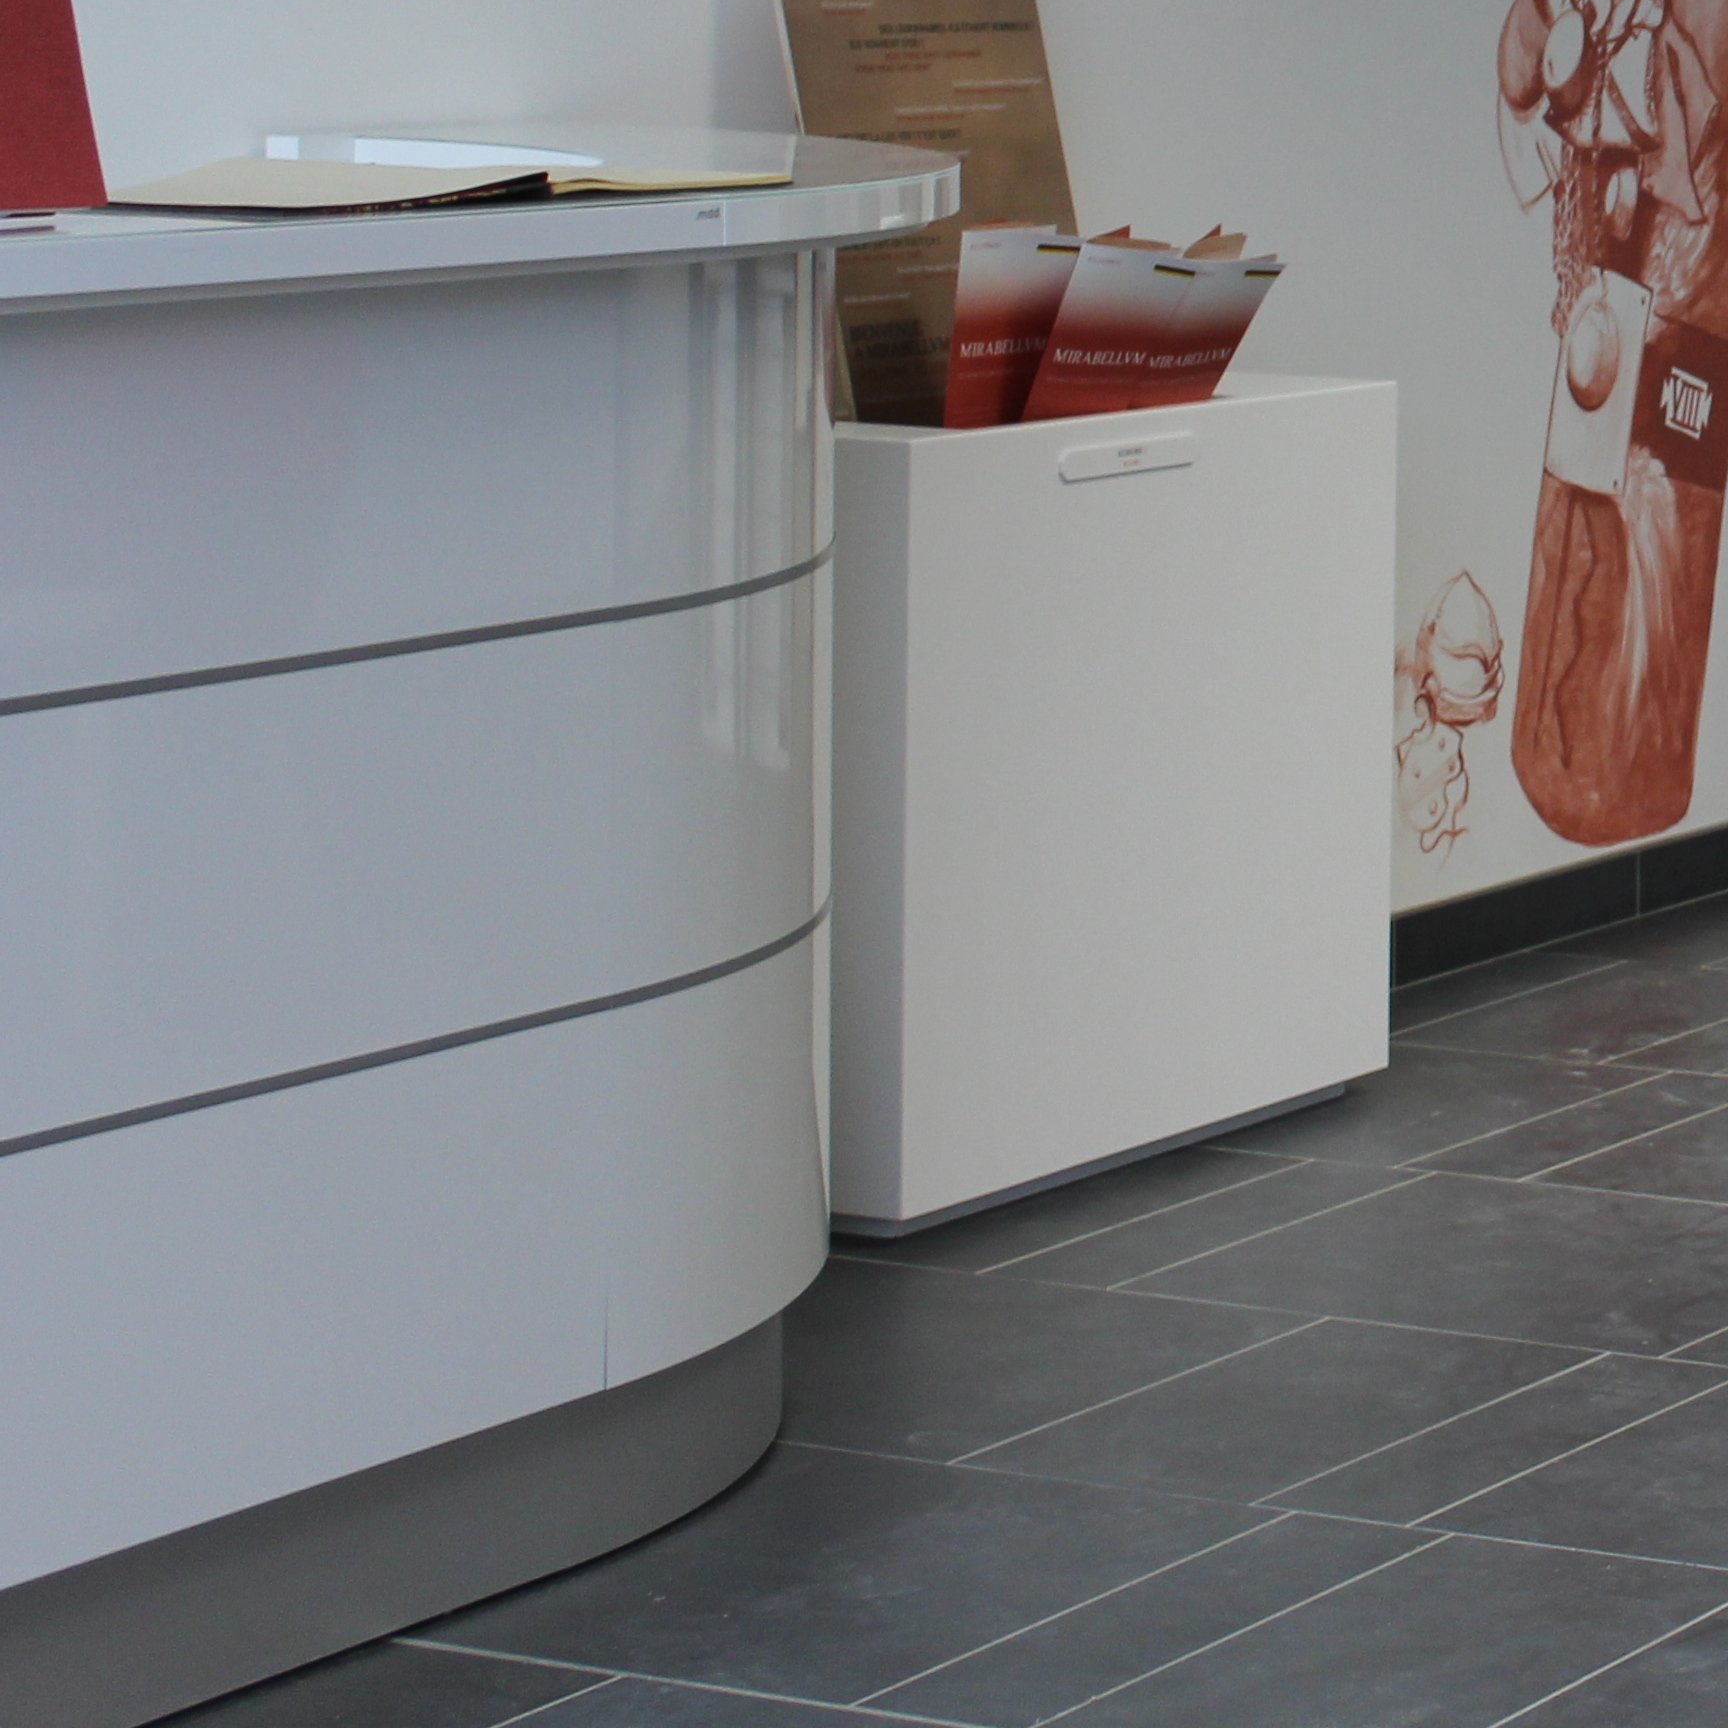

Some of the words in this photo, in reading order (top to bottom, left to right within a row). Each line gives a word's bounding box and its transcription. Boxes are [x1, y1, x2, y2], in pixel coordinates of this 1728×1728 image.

[959, 336, 1048, 359] MIRABELLVM
[1053, 347, 1146, 367] MIRABELLVM
[1148, 347, 1232, 370] MIRABELLVM
